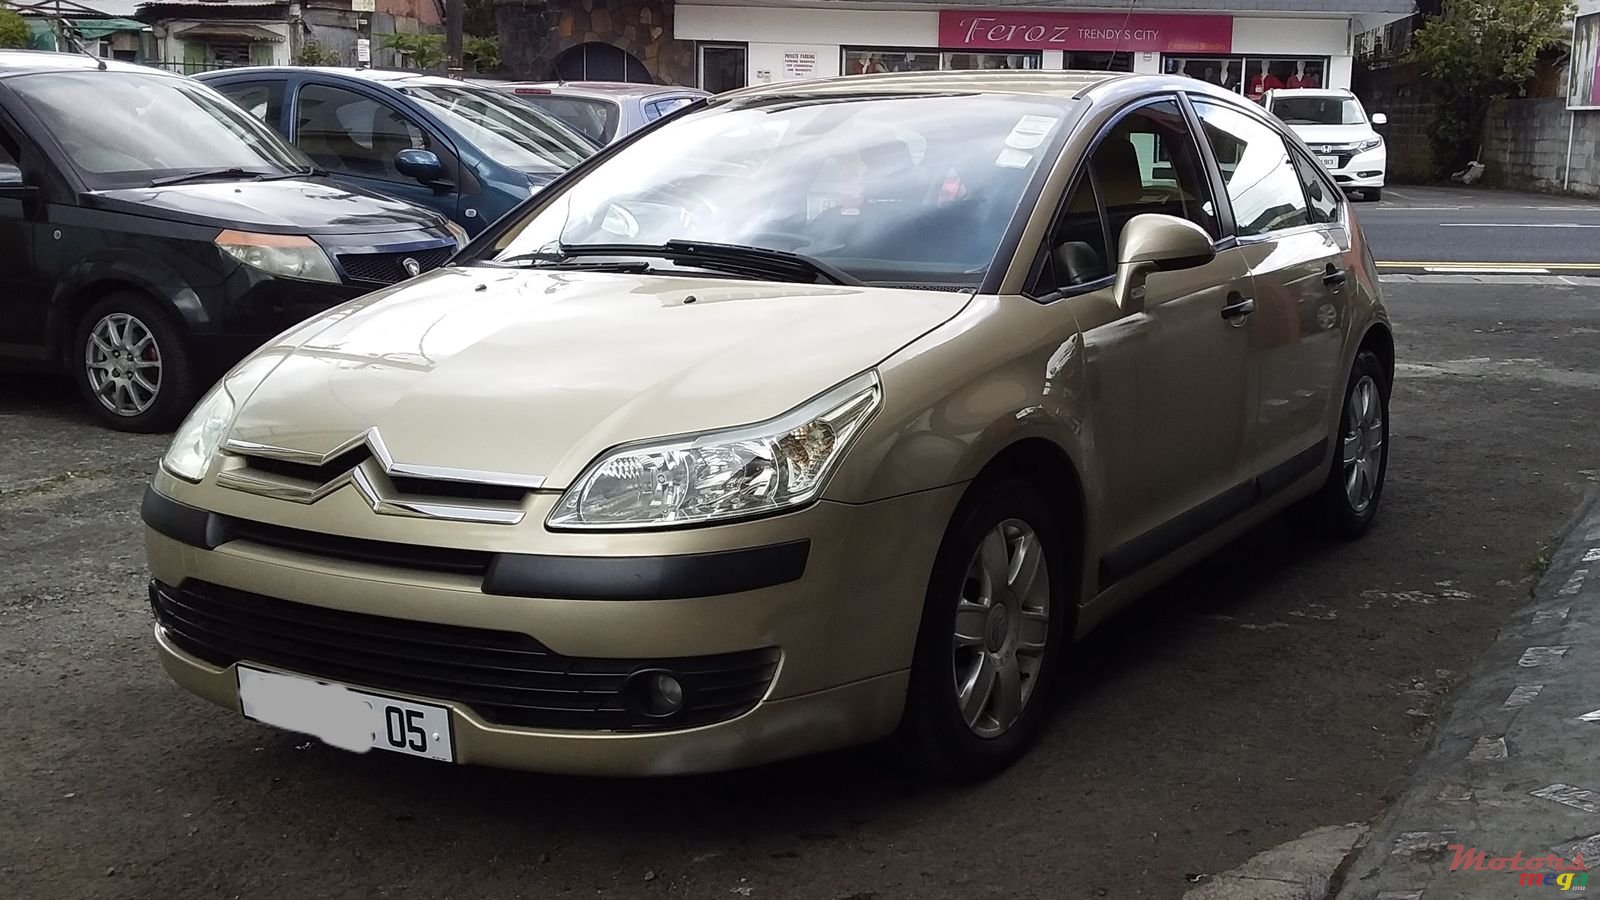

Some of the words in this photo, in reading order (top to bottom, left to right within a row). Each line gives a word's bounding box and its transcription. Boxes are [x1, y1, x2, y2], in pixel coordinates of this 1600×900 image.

[959, 17, 1070, 43] Feroz
[1078, 28, 1131, 40] TRENDYS
[1134, 29, 1159, 41] CITY
[385, 706, 427, 752] 05
